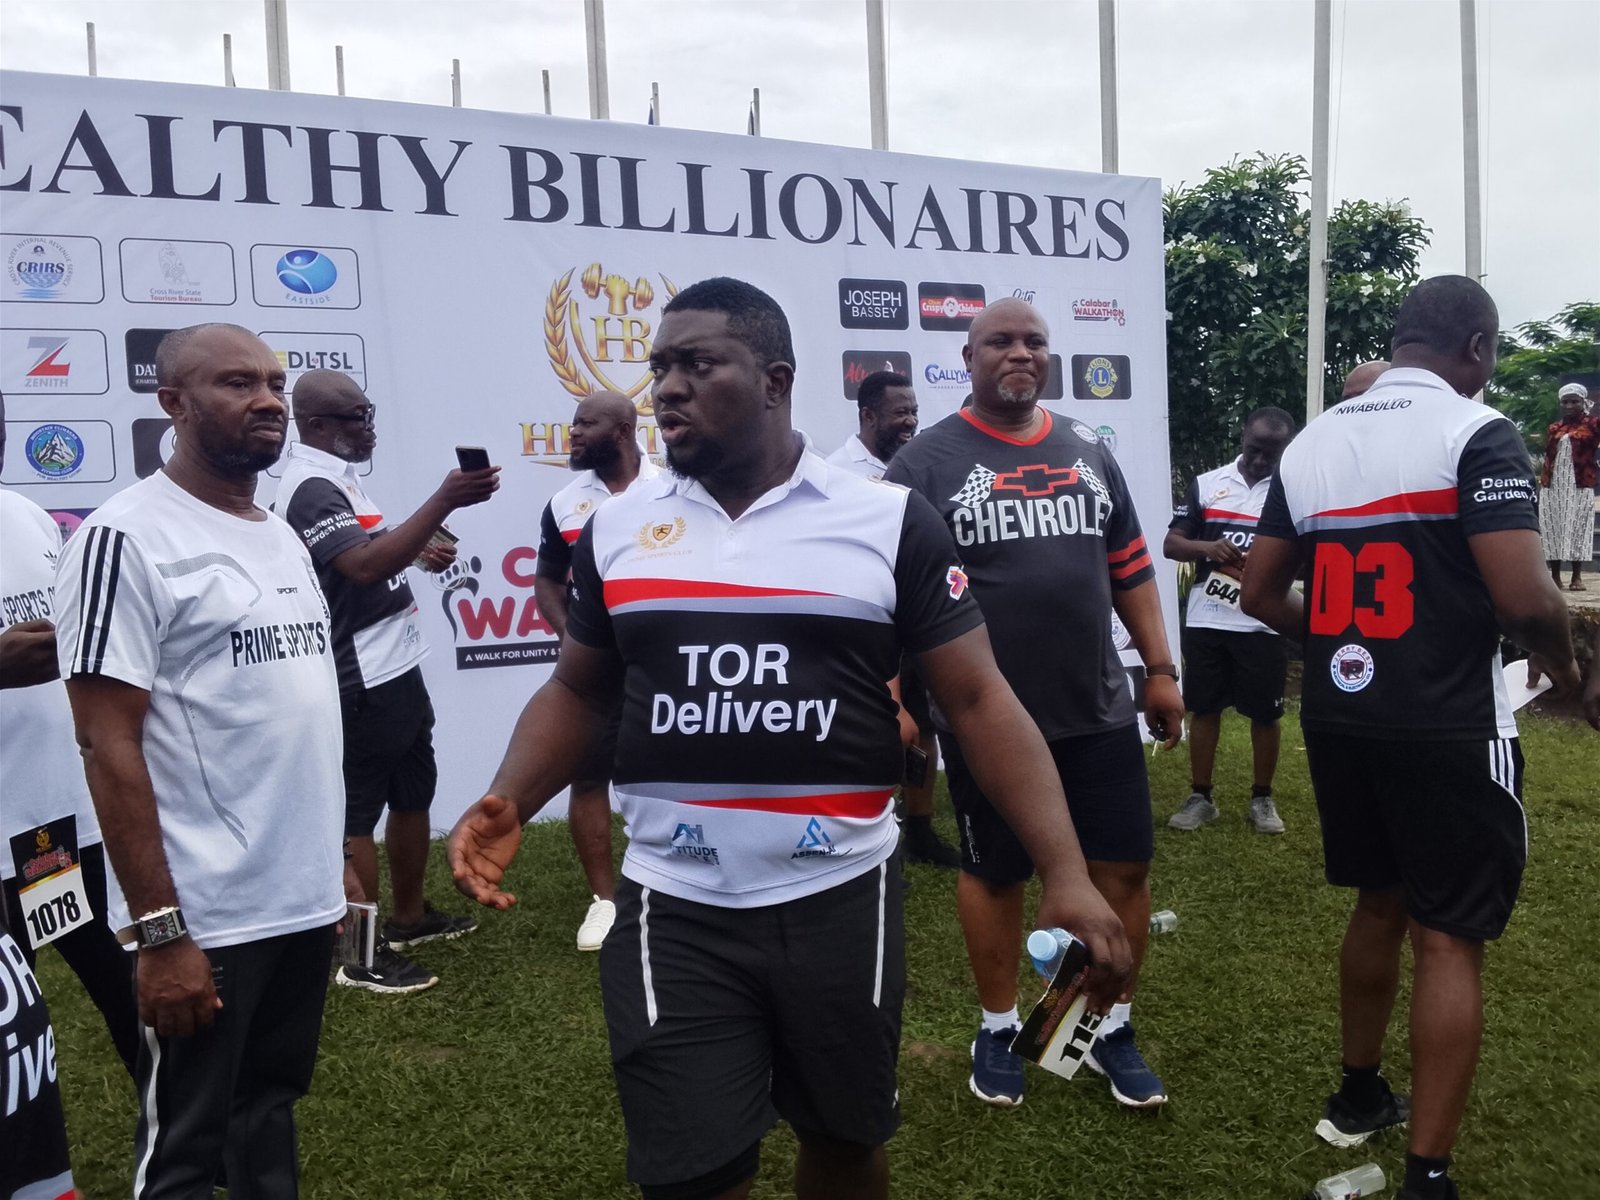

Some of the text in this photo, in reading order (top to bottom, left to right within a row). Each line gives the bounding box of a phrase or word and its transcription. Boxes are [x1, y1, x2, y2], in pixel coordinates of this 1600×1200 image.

[499, 144, 1132, 263] BILLIONAIRES
[16, 261, 65, 274] CRIRS
[150, 288, 168, 296] Cross
[285, 292, 331, 305] EASTSIDE
[844, 290, 902, 307] JOSEPH
[1080, 299, 1111, 308] Calabar
[851, 306, 898, 319] BASSEY
[1074, 307, 1124, 318] WALKATHON
[590, 316, 652, 363] HB
[1091, 359, 1111, 369] LIONS
[24, 377, 69, 388] ZENITH
[1474, 489, 1529, 503] Garden
[306, 525, 336, 548] Garden
[276, 587, 298, 595] SPORT
[1205, 578, 1240, 605] 644
[3, 589, 50, 626] SPORTS
[230, 621, 326, 668] PRIME SPORTS
[465, 654, 473, 662] A
[475, 651, 501, 661] WALK
[502, 650, 521, 659] FOR
[522, 648, 549, 658] UNITY
[550, 648, 557, 656] &
[678, 643, 790, 687] TOR
[650, 691, 838, 742] Delivery
[27, 890, 81, 942] 1078
